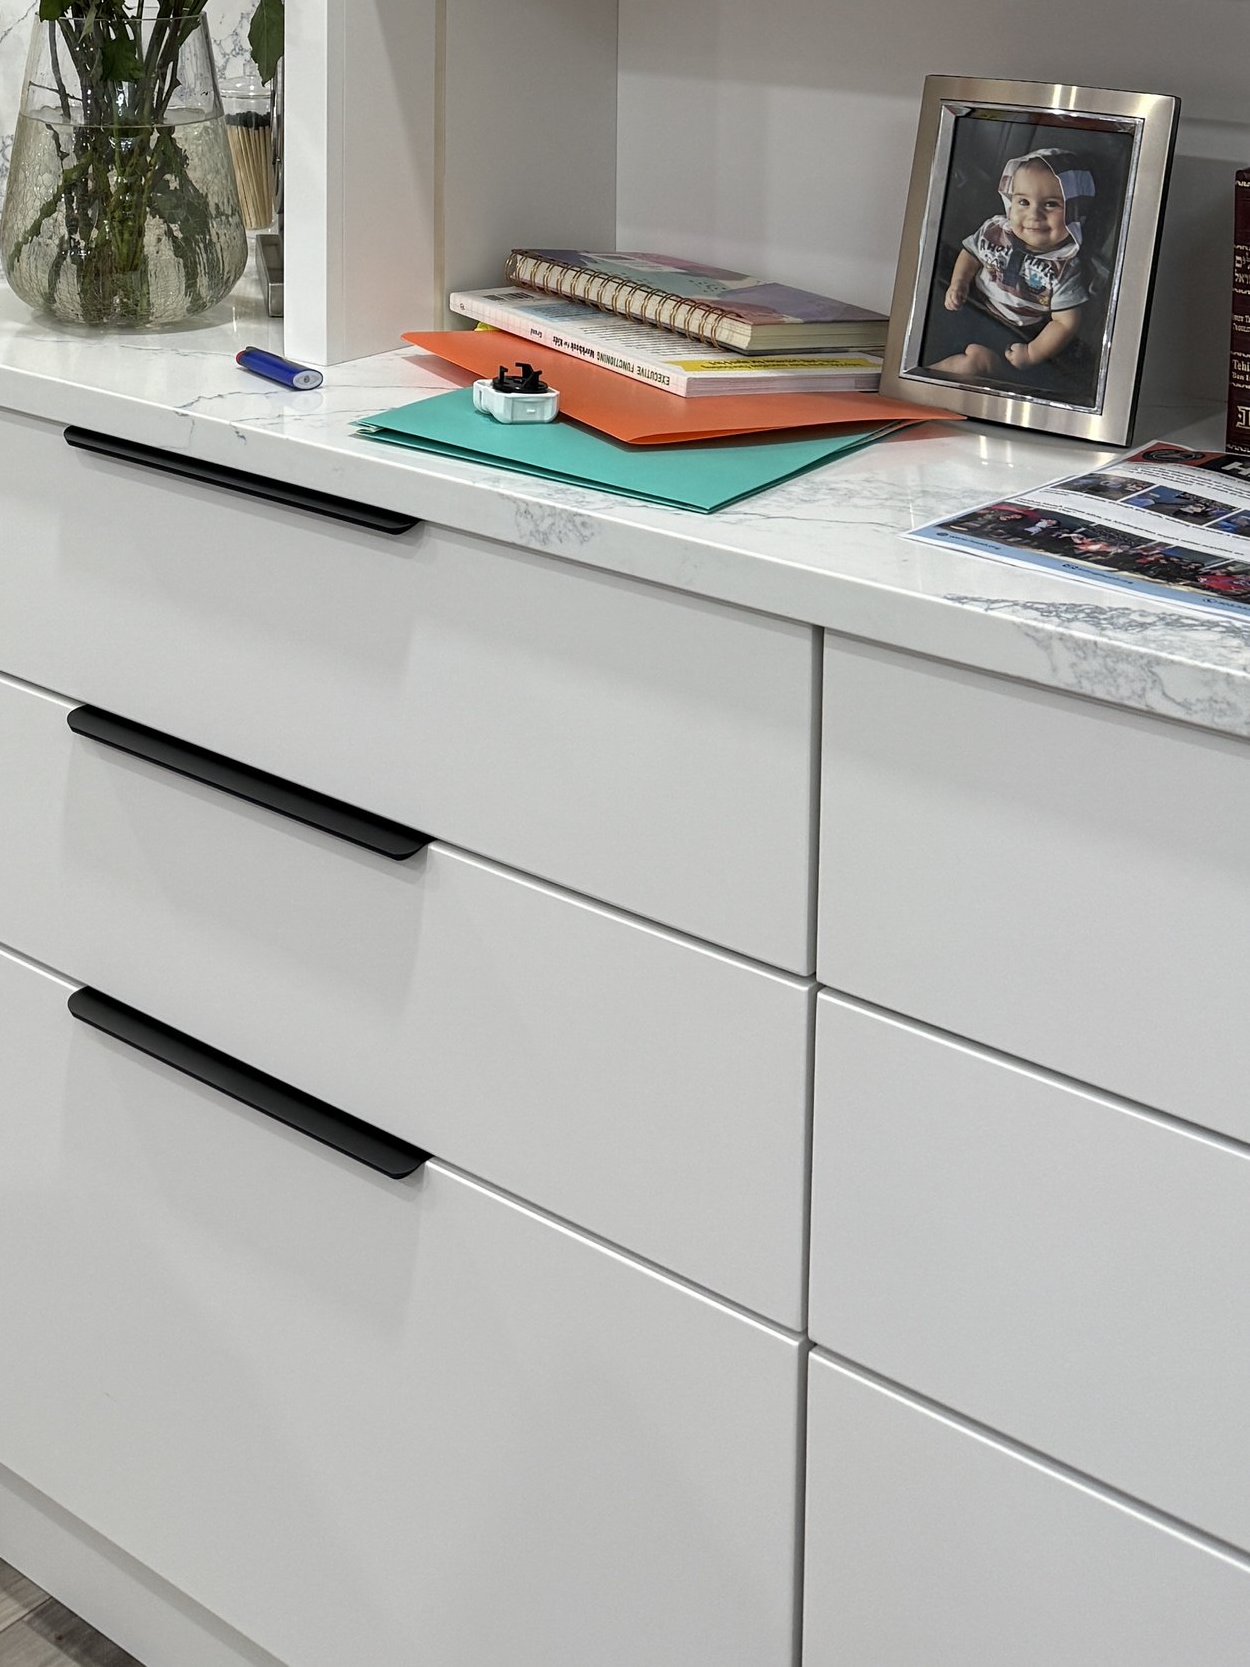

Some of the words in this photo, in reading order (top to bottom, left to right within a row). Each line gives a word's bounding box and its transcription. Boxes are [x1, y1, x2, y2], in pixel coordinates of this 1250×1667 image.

[552, 336, 563, 346] Kids
[571, 342, 595, 358] Workbook
[597, 351, 635, 373] FUNCTIONING
[637, 366, 670, 386] EXECUTIVE
